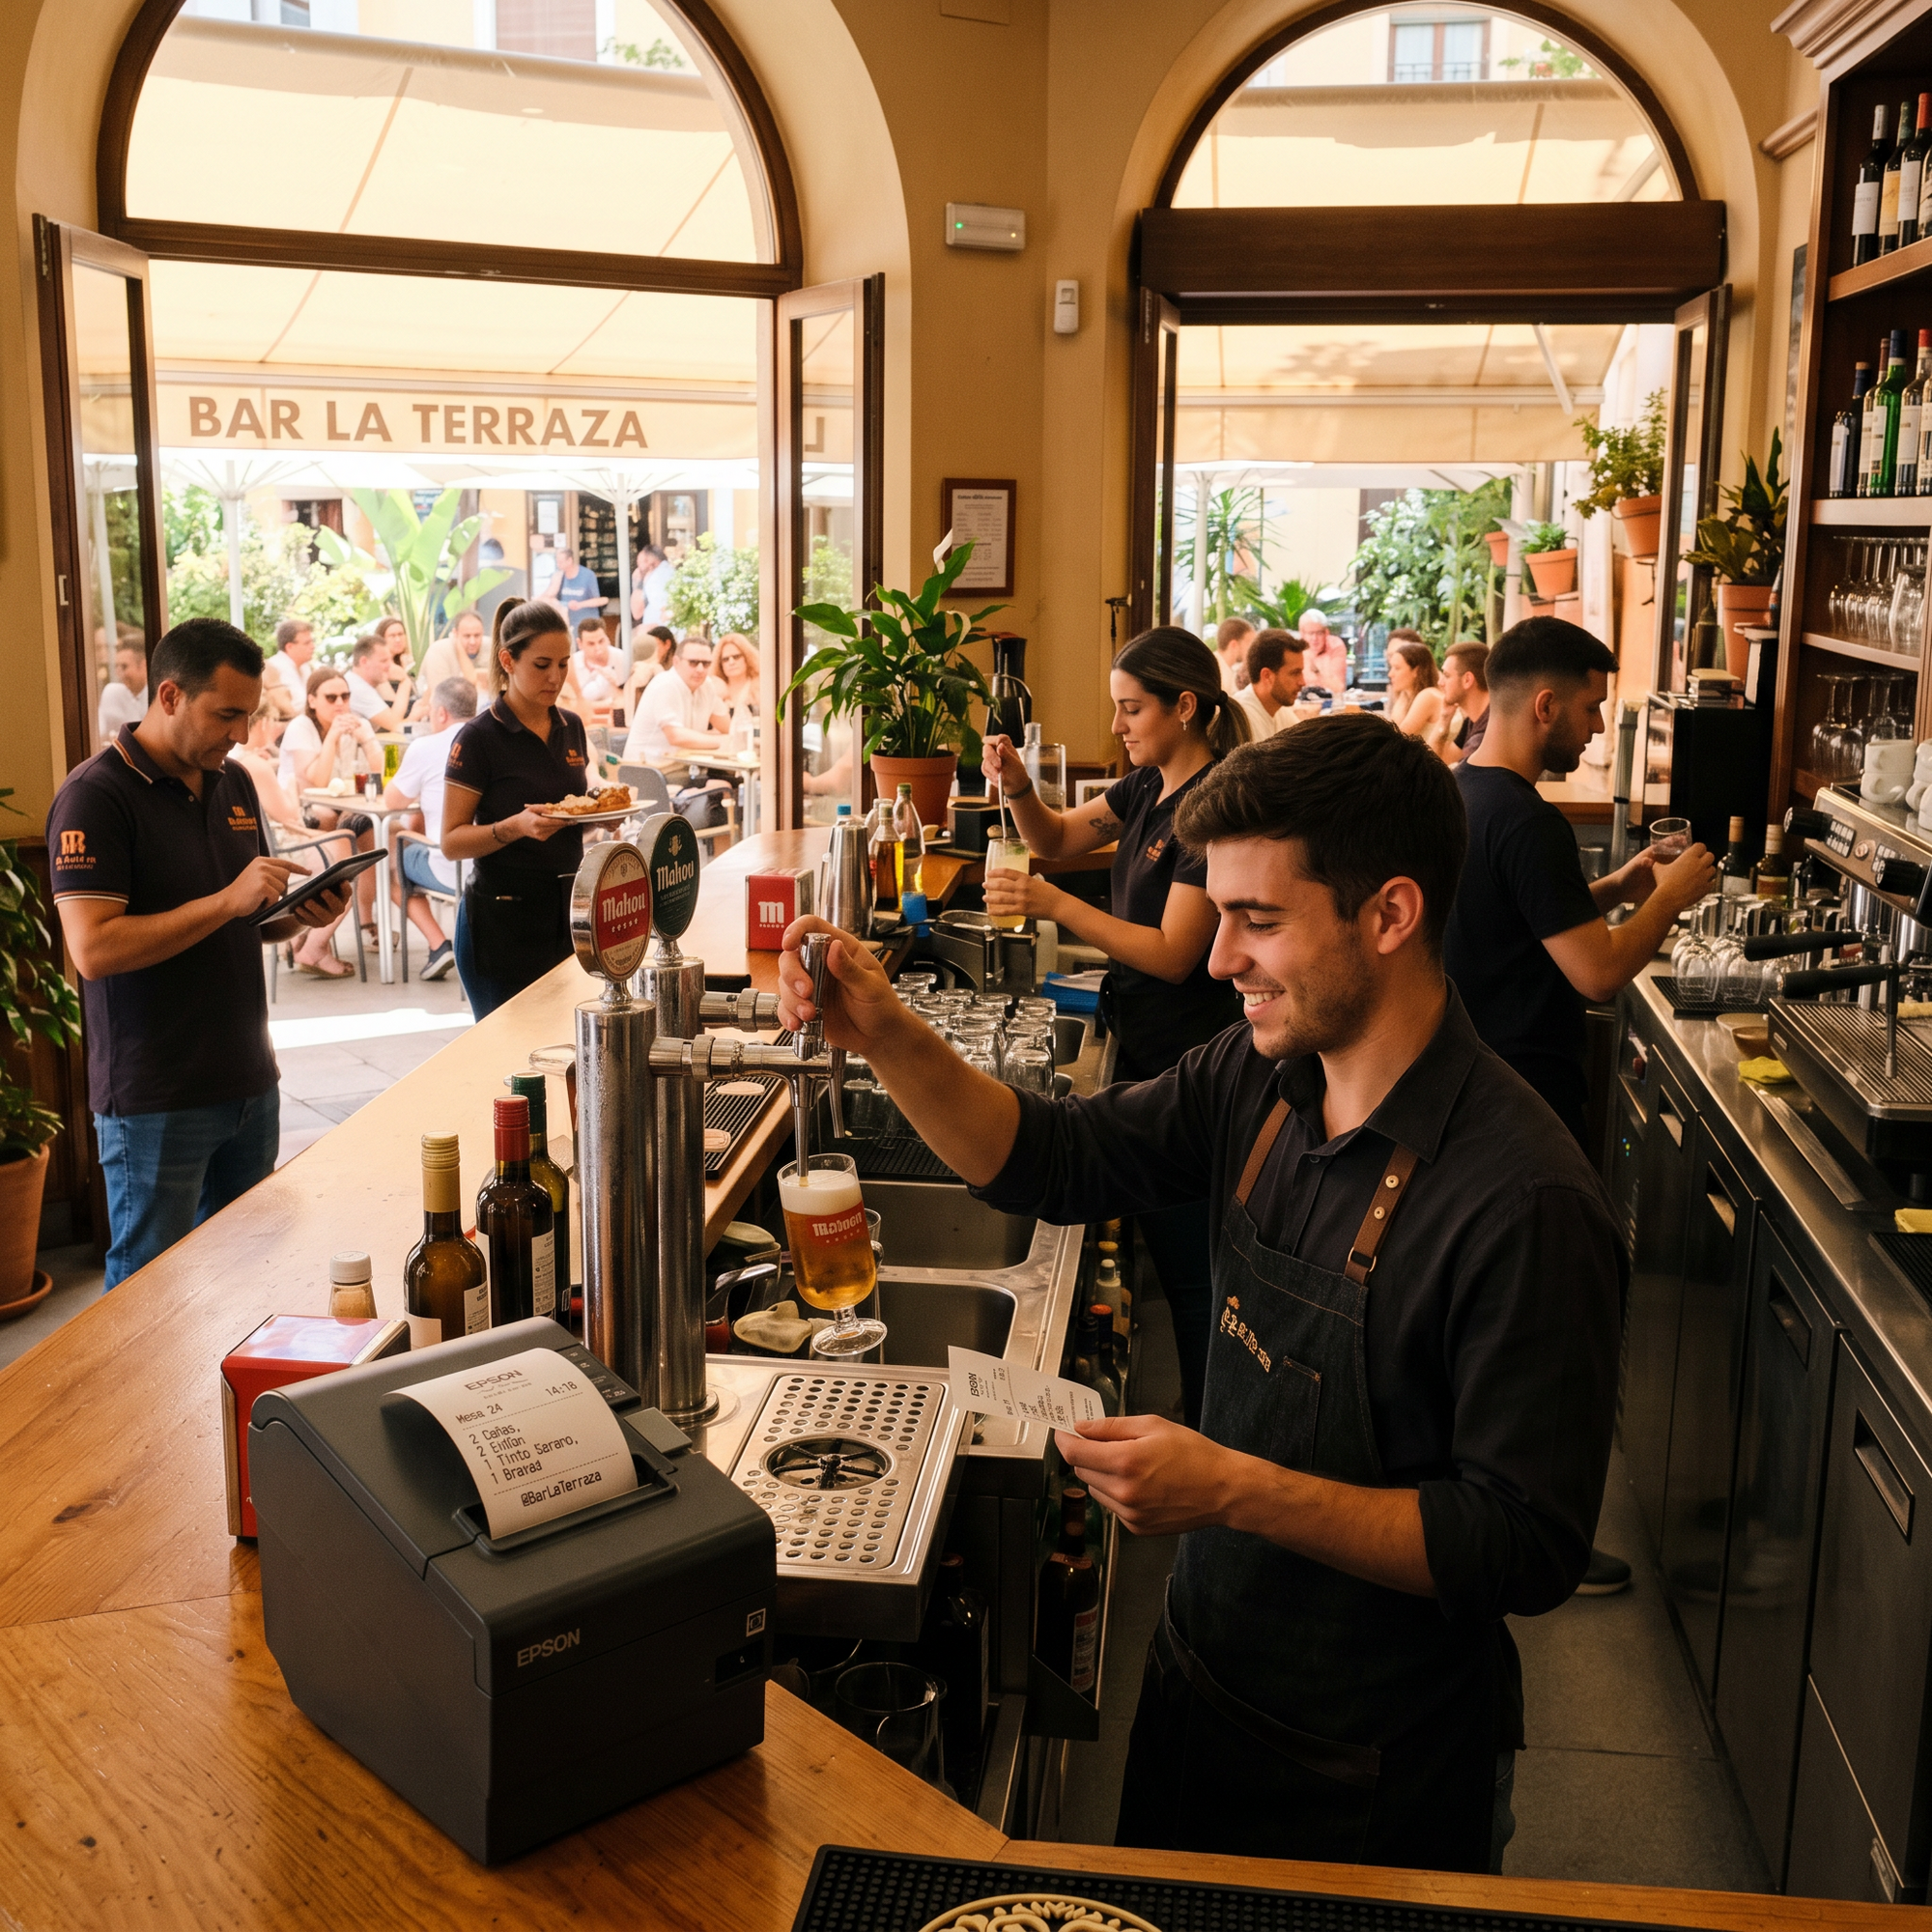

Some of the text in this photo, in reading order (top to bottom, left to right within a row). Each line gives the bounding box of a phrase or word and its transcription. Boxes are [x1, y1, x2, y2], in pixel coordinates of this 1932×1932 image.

[188, 396, 648, 448] BAR LA TERRAZA
[656, 860, 695, 892] Mahou
[602, 892, 646, 923] Mahou
[464, 1369, 523, 1391] EPSON
[456, 1409, 486, 1424] Mesa
[545, 1380, 578, 1397] 14:18
[469, 1434, 479, 1445] 2
[476, 1445, 487, 1458] 2
[484, 1459, 493, 1470] 1
[497, 1448, 531, 1467] Tinto
[491, 1472, 499, 1485] 1
[517, 1628, 581, 1668] EPSON
